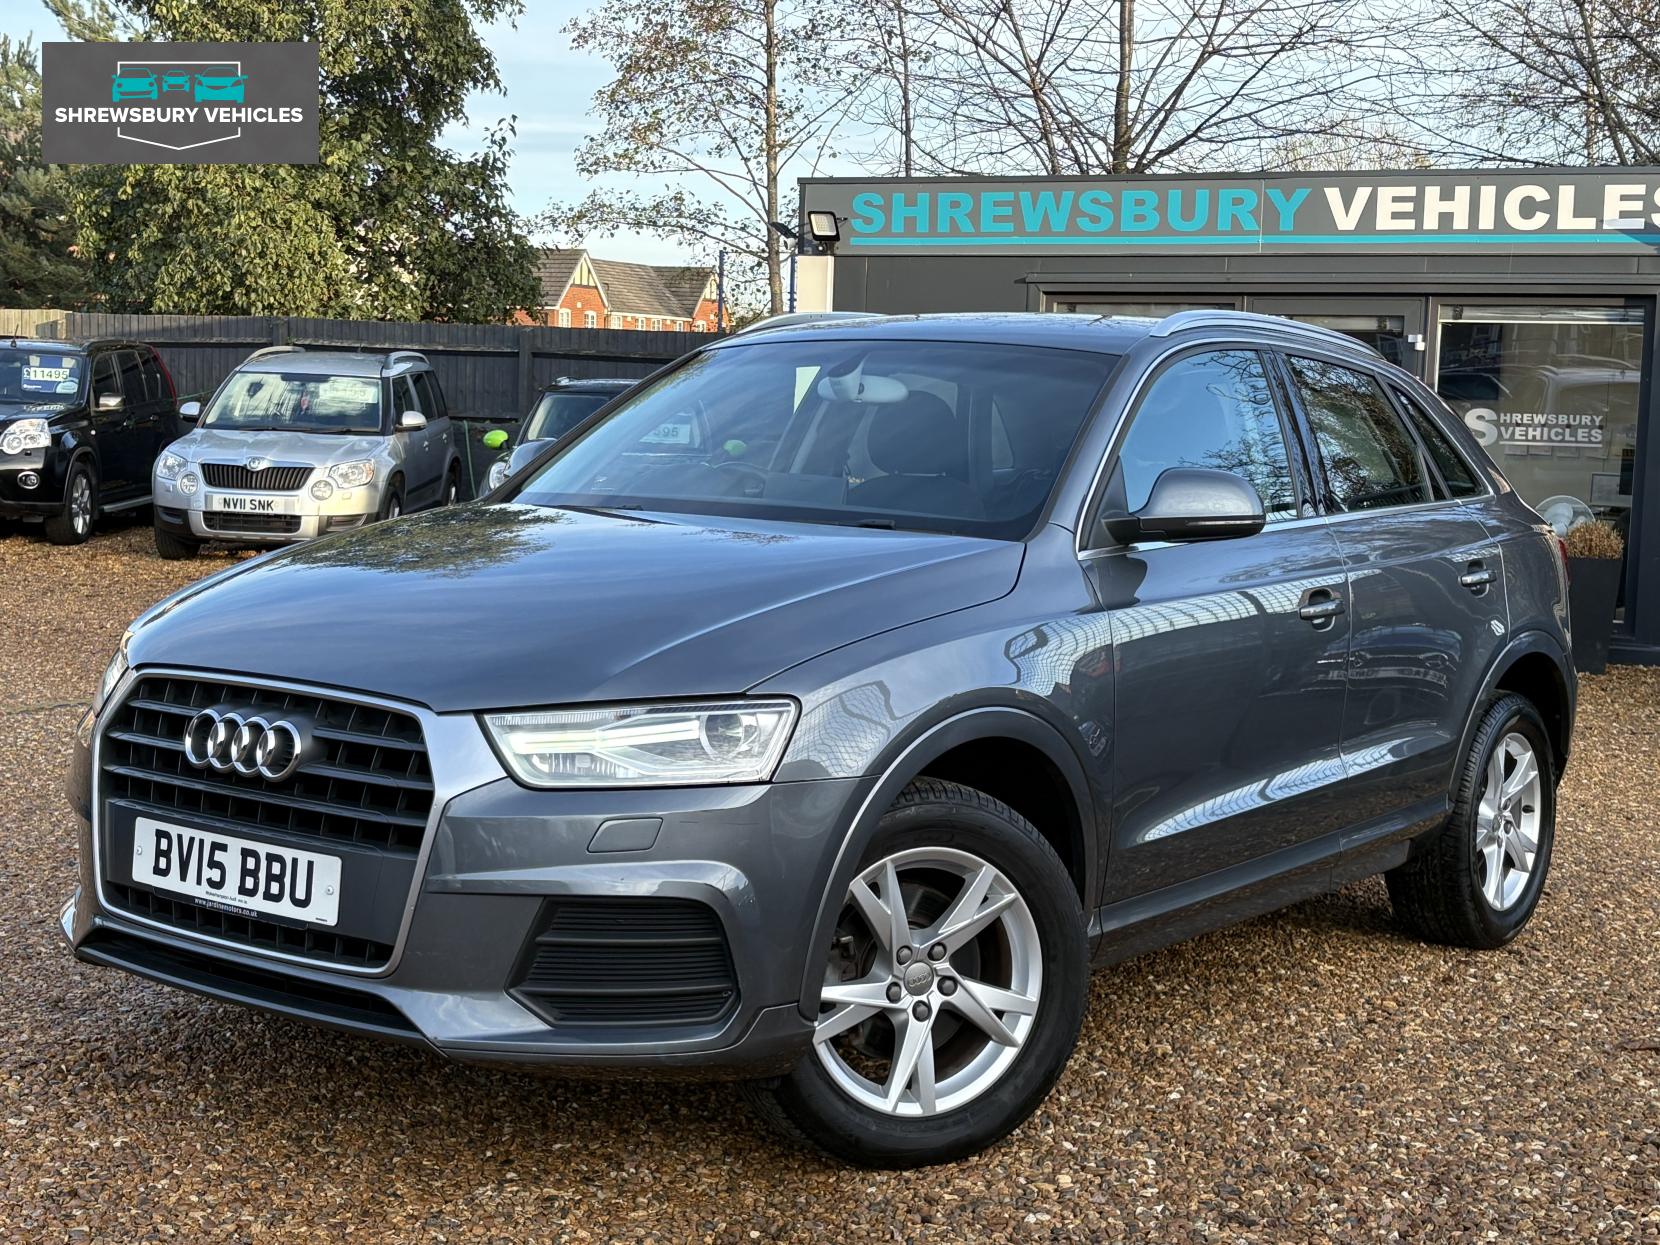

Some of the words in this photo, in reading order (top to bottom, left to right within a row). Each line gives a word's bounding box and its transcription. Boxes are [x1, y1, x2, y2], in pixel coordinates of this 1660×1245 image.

[850, 188, 1313, 234] SHREWSBURY
[1324, 183, 1660, 231] VEHICLE
[1500, 426, 1603, 442] VEHICLES
[223, 497, 246, 510] NV11
[249, 499, 274, 512] SNK
[153, 828, 228, 890] BV15
[238, 847, 314, 909] BBU
